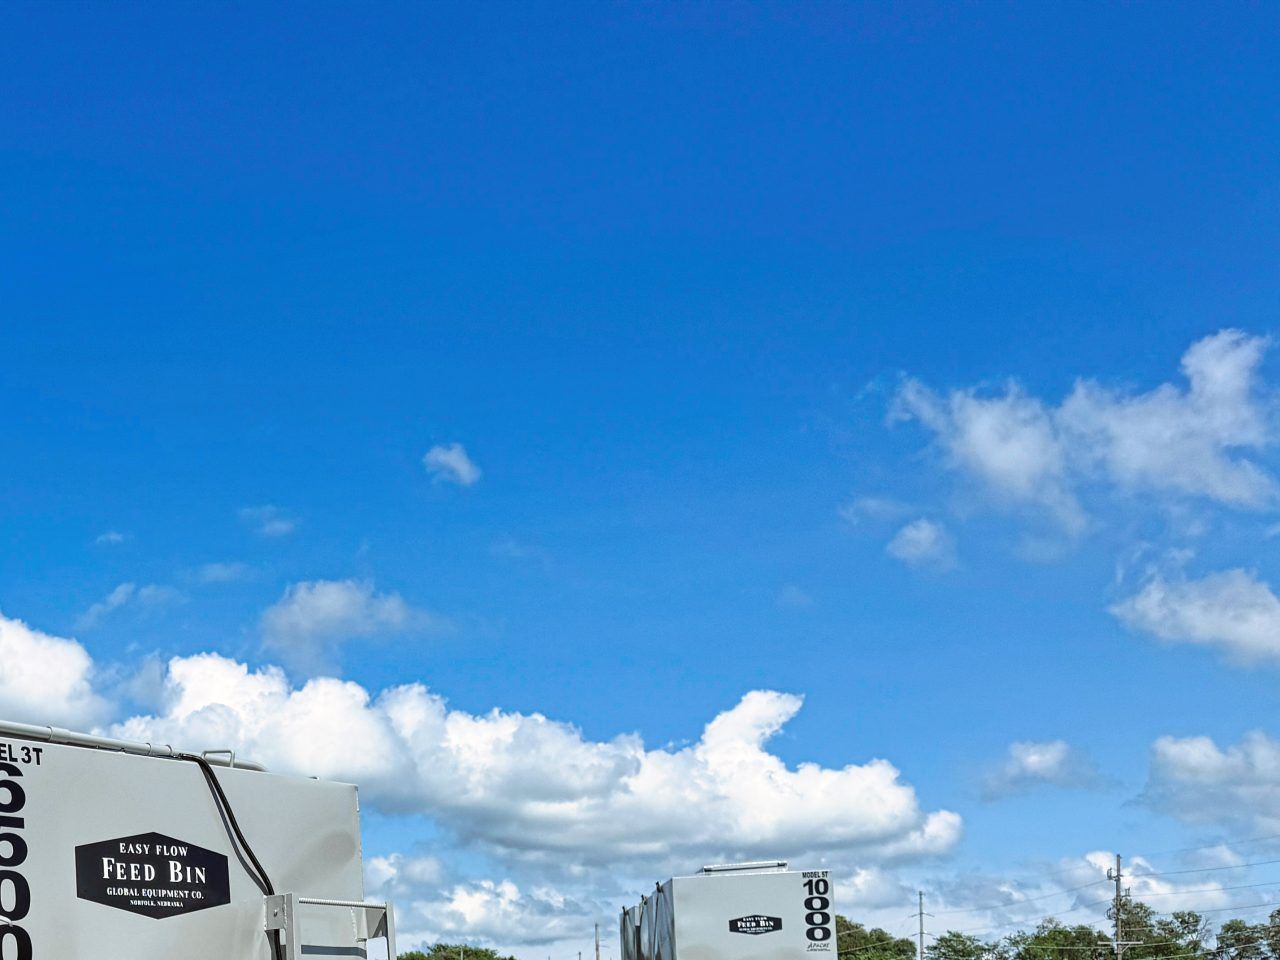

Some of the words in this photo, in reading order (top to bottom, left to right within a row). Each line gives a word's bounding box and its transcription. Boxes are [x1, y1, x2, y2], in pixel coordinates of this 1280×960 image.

[20, 746, 43, 766] 3T
[119, 842, 150, 855] EASY
[156, 844, 188, 857] FLOW
[102, 857, 156, 882] FEED
[168, 860, 206, 884] BIN
[106, 887, 140, 896] GLOBAL
[142, 888, 190, 899] EQUIPMENT
[191, 890, 204, 900] CO.
[129, 899, 156, 907] NORFOLK,
[157, 900, 184, 908] NEBRASKA
